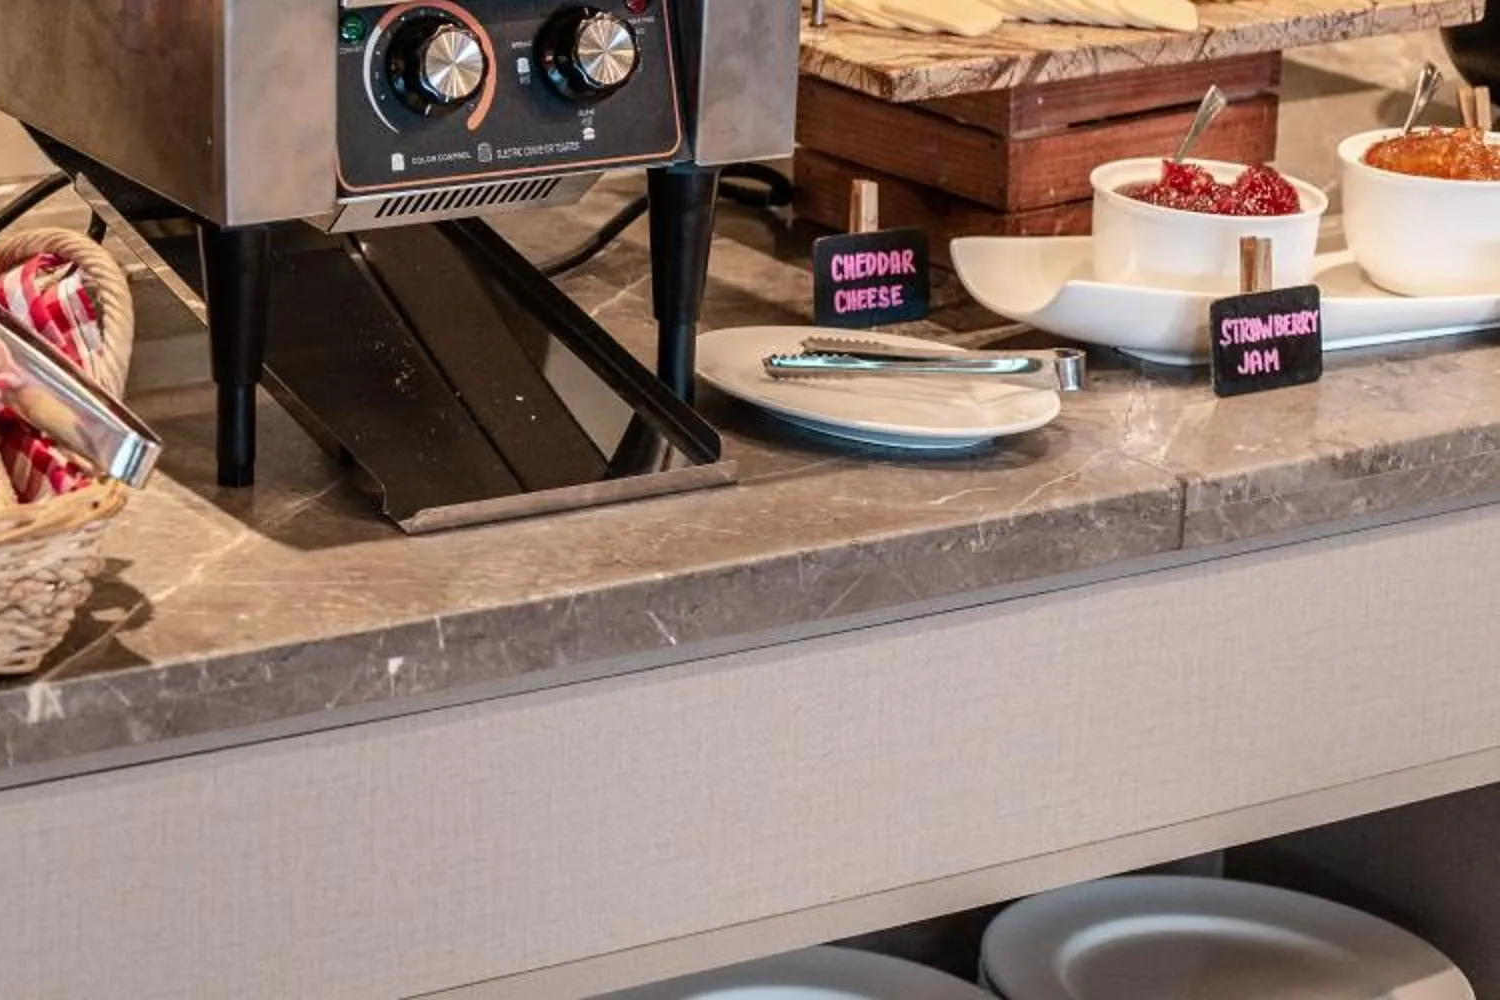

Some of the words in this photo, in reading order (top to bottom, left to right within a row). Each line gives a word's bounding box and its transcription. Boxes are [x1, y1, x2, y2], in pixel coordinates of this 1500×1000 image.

[831, 248, 916, 282] CHEDDAR
[835, 284, 904, 314] CHEESE
[1219, 309, 1319, 346] STRAWBERRY
[1237, 347, 1280, 375] JAM
